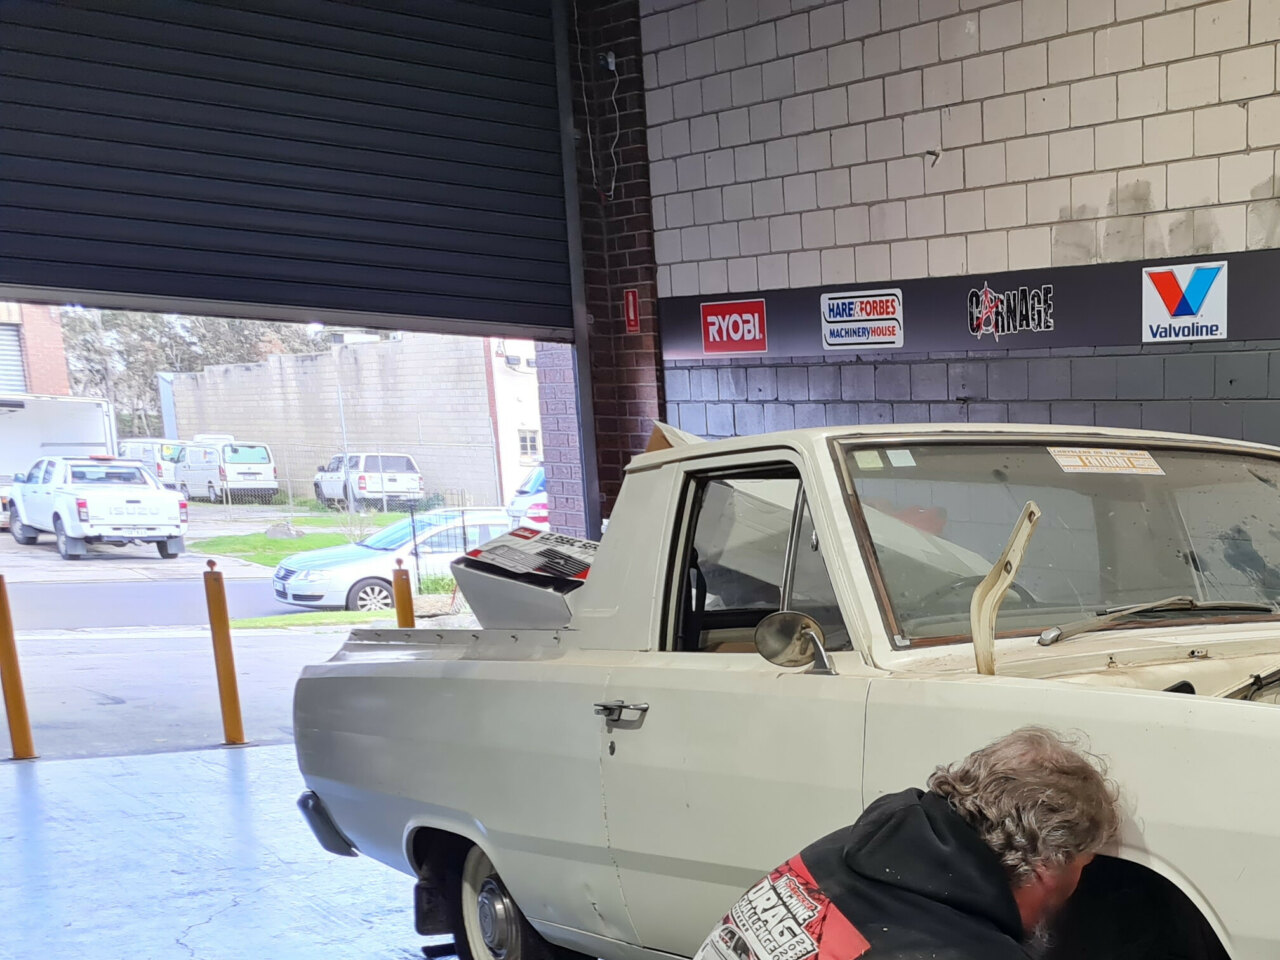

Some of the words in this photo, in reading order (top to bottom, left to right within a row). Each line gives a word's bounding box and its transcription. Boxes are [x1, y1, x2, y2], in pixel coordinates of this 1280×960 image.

[707, 312, 762, 342] RYOBI
[968, 281, 1054, 342] CARNAGE
[1148, 322, 1219, 339] Valvoline
[109, 507, 160, 516] ISUZU
[740, 895, 780, 955] CHALLENGE
[747, 878, 803, 946] DRAG
[774, 876, 815, 925] MACHINE
